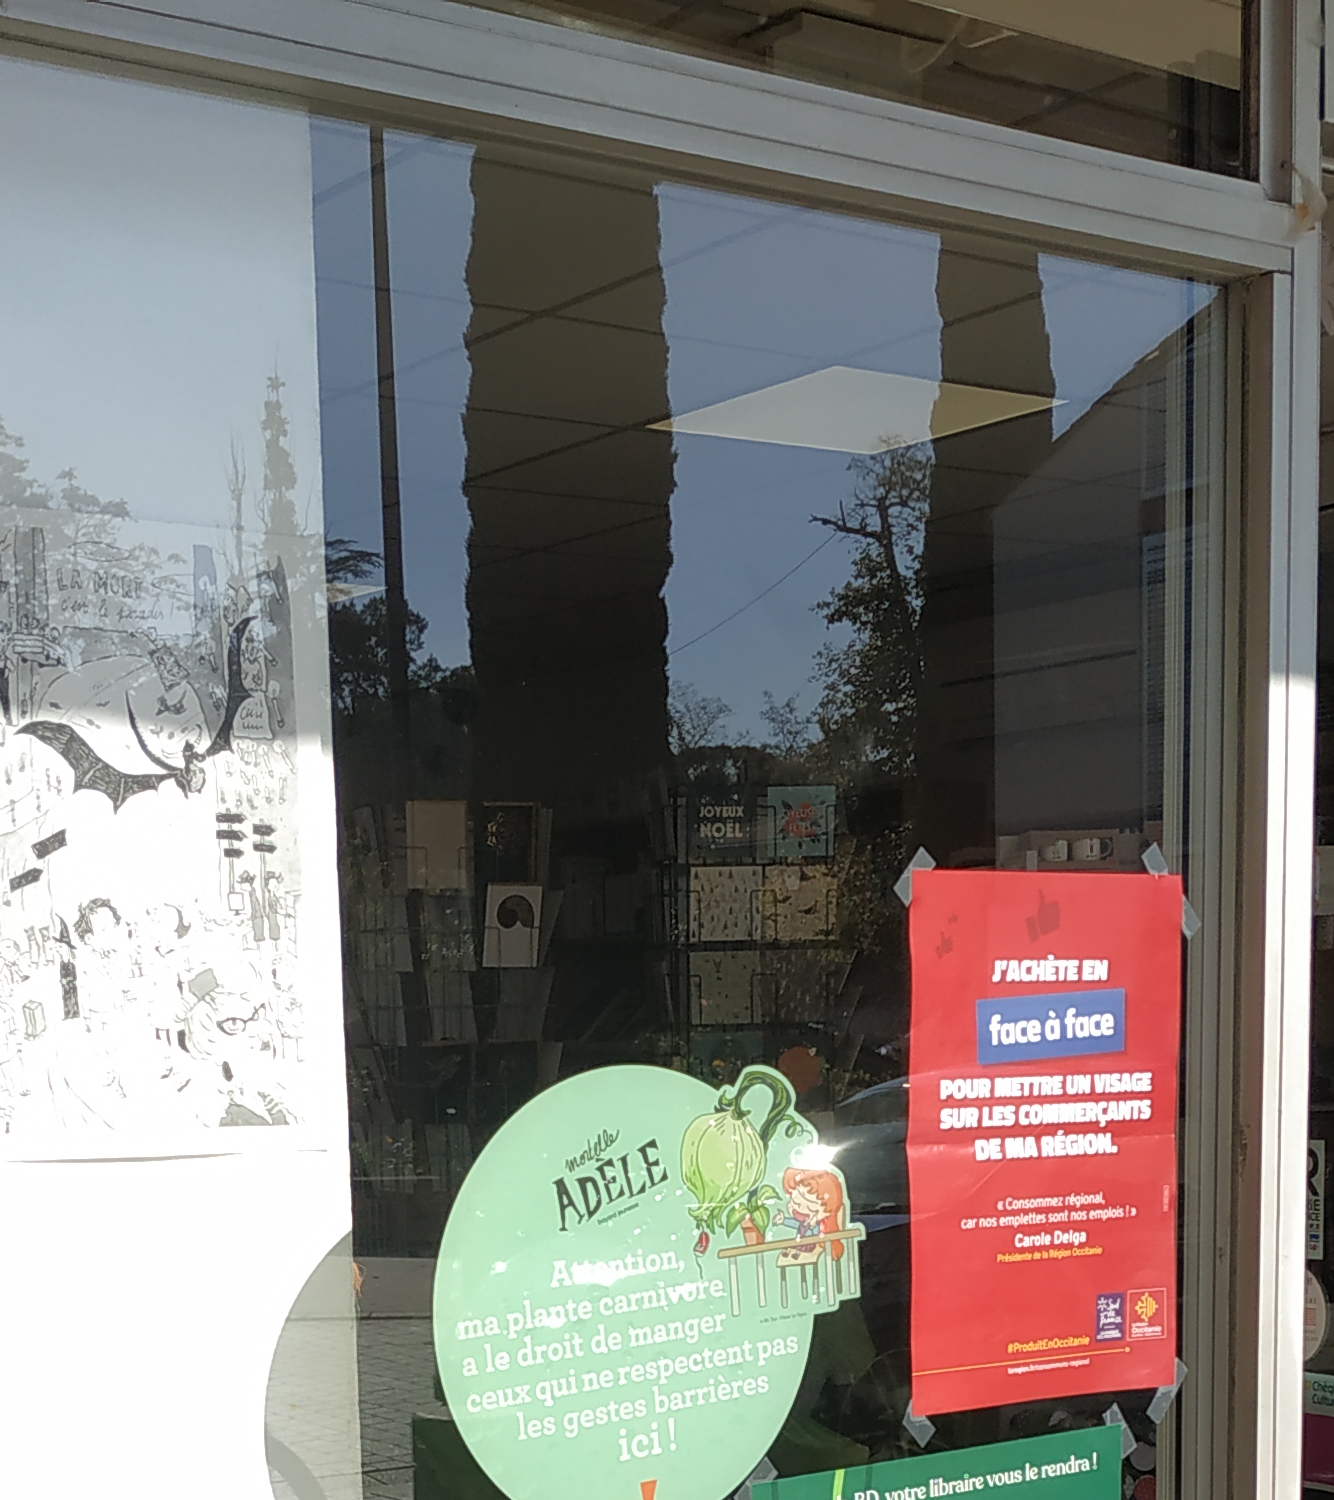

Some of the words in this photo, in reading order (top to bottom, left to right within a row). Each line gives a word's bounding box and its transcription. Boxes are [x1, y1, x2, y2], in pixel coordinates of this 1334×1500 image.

[699, 805, 744, 818] JOYEUX
[699, 819, 743, 838] NOËL
[1082, 959, 1108, 981] EN
[989, 1014, 1041, 1046] face
[1045, 1010, 1060, 1040] à
[1064, 1007, 1114, 1039] face
[939, 1078, 991, 1100] POUR
[994, 1075, 1063, 1098] METTRE
[1066, 1074, 1091, 1095] UN
[1094, 1072, 1152, 1093] VISAGE
[939, 1107, 979, 1129] SUR
[982, 1105, 1015, 1127] LES
[1019, 1100, 1152, 1127] COMMERÇANTS
[565, 1129, 620, 1173] mortelle
[974, 1138, 1002, 1161] DE
[1005, 1137, 1038, 1159] MA
[1041, 1130, 1118, 1158] RÉGION.
[552, 1137, 669, 1232] ADÈLE
[1005, 1197, 1063, 1210] Consommez
[1065, 1191, 1105, 1208] régional,
[961, 1218, 977, 1229] car
[979, 1215, 997, 1228] nos
[999, 1210, 1046, 1228] emplettes
[1048, 1209, 1068, 1224] sont
[1070, 1210, 1087, 1221] nos
[1089, 1205, 1124, 1222] emplois
[1015, 1231, 1051, 1248] Carole
[1054, 1229, 1087, 1246] Delga
[996, 1252, 1032, 1263] Présidente
[1049, 1247, 1071, 1260] Région
[1072, 1246, 1102, 1257] Occitanie
[457, 1316, 501, 1340] ma
[507, 1299, 593, 1339] plante
[599, 1279, 724, 1316] carnivore
[462, 1357, 478, 1377] a
[484, 1344, 510, 1374] le
[516, 1333, 584, 1368] droit
[590, 1324, 623, 1355] de
[628, 1312, 726, 1346] manger
[466, 1384, 531, 1413] ceux
[535, 1369, 579, 1408] qui
[582, 1369, 614, 1392] ne
[617, 1340, 753, 1384] respectent
[756, 1335, 799, 1366] pas
[517, 1412, 556, 1440] les
[563, 1396, 647, 1438] gestes
[652, 1374, 769, 1414] barrières
[618, 1421, 663, 1461] ici
[929, 1474, 984, 1498] libraire
[986, 1468, 1023, 1487] vous
[1025, 1463, 1039, 1481] le
[1040, 1456, 1090, 1477] rendra
